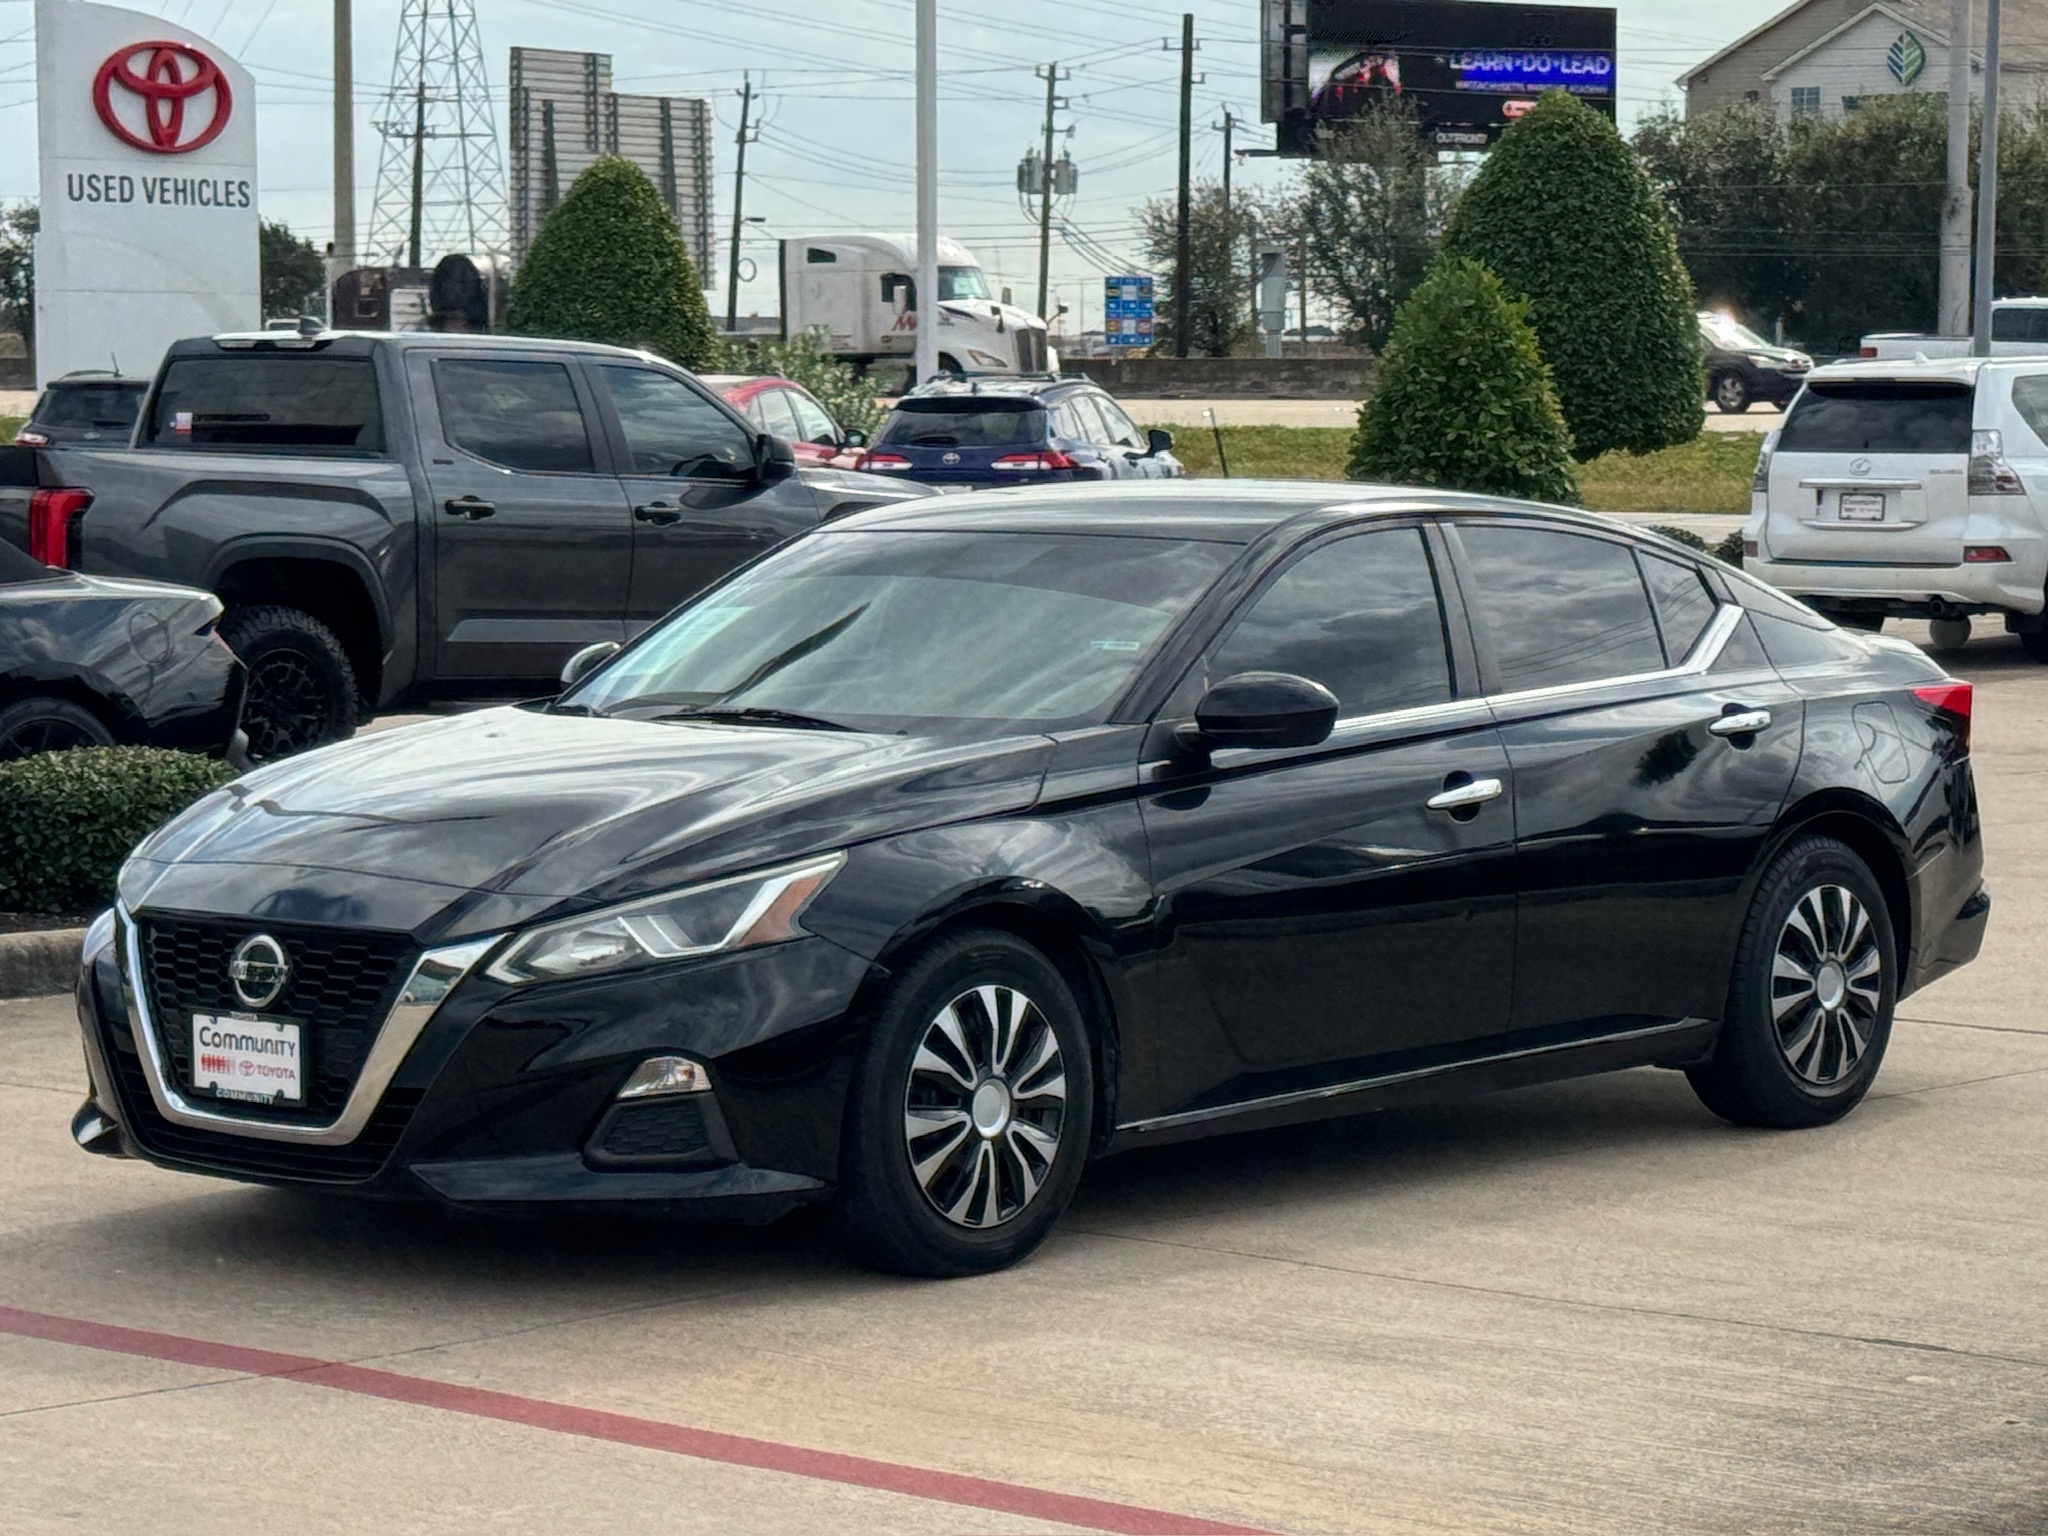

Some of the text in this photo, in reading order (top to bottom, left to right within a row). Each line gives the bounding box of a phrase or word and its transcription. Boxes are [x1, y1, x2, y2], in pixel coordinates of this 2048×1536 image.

[67, 172, 251, 209] USED VEHICLES
[256, 1064, 297, 1081] TOYOTA
